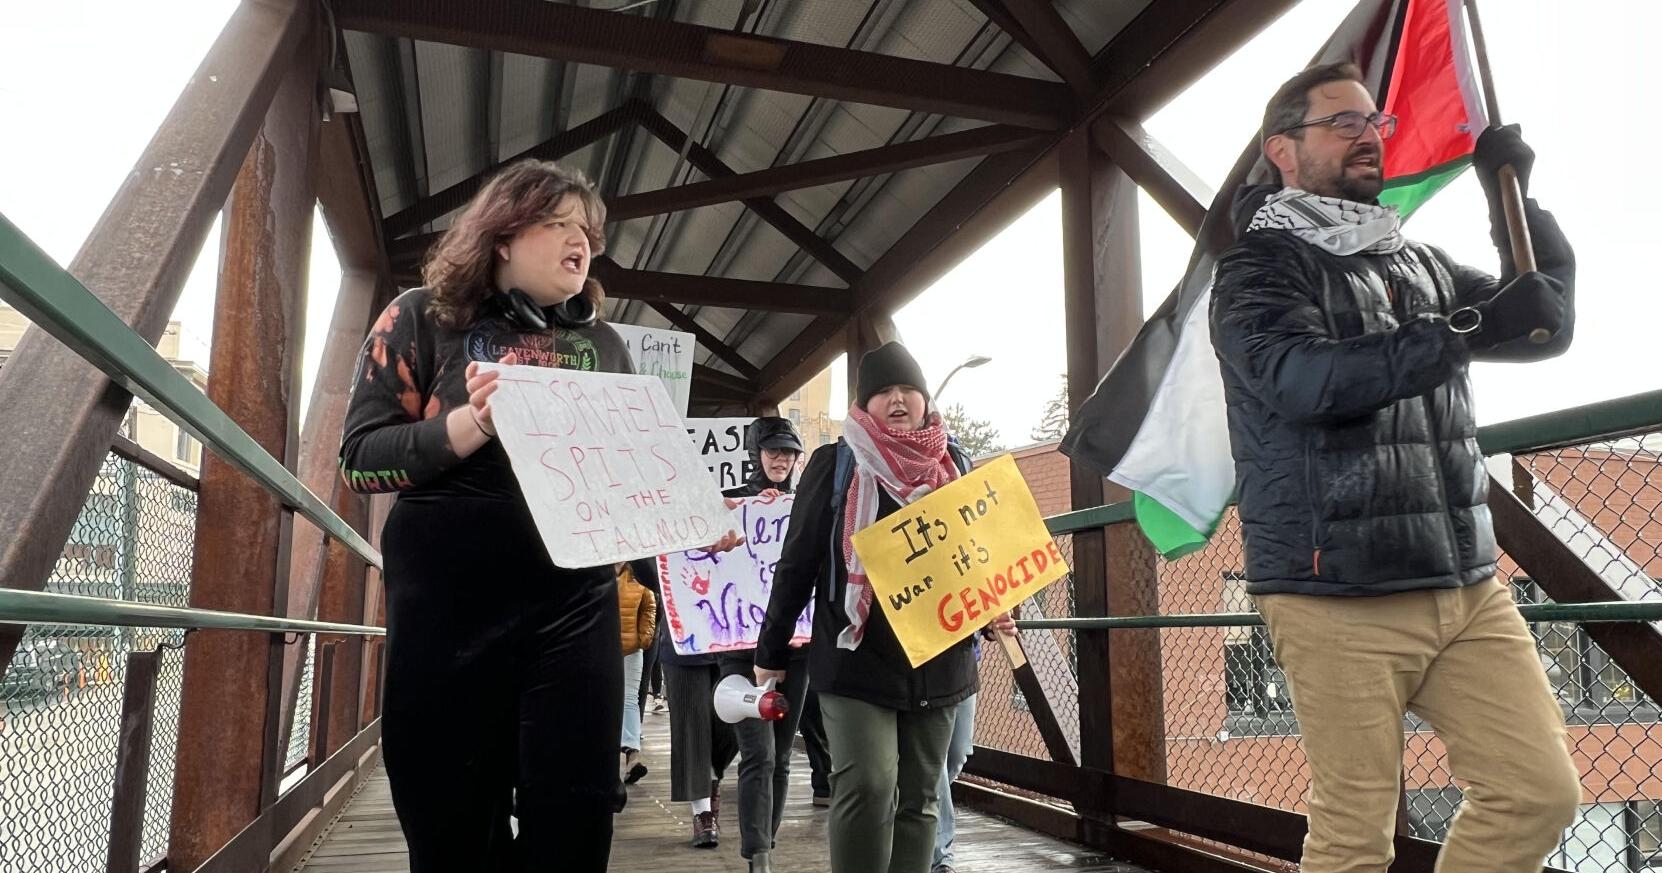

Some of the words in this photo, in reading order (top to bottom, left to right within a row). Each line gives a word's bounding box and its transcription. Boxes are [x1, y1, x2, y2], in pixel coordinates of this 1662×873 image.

[492, 344, 578, 367] LEAVENWORTH
[642, 334, 682, 354] Can't
[497, 379, 678, 437] ISRAEL
[540, 445, 677, 501] SPITS
[576, 501, 610, 522] ON
[626, 489, 671, 509] THE
[891, 511, 948, 564] It's
[958, 480, 999, 526] not
[572, 515, 709, 554] TALMUD
[889, 575, 933, 611] war
[952, 540, 989, 576] it's
[937, 541, 1063, 632] GENOCIDE
